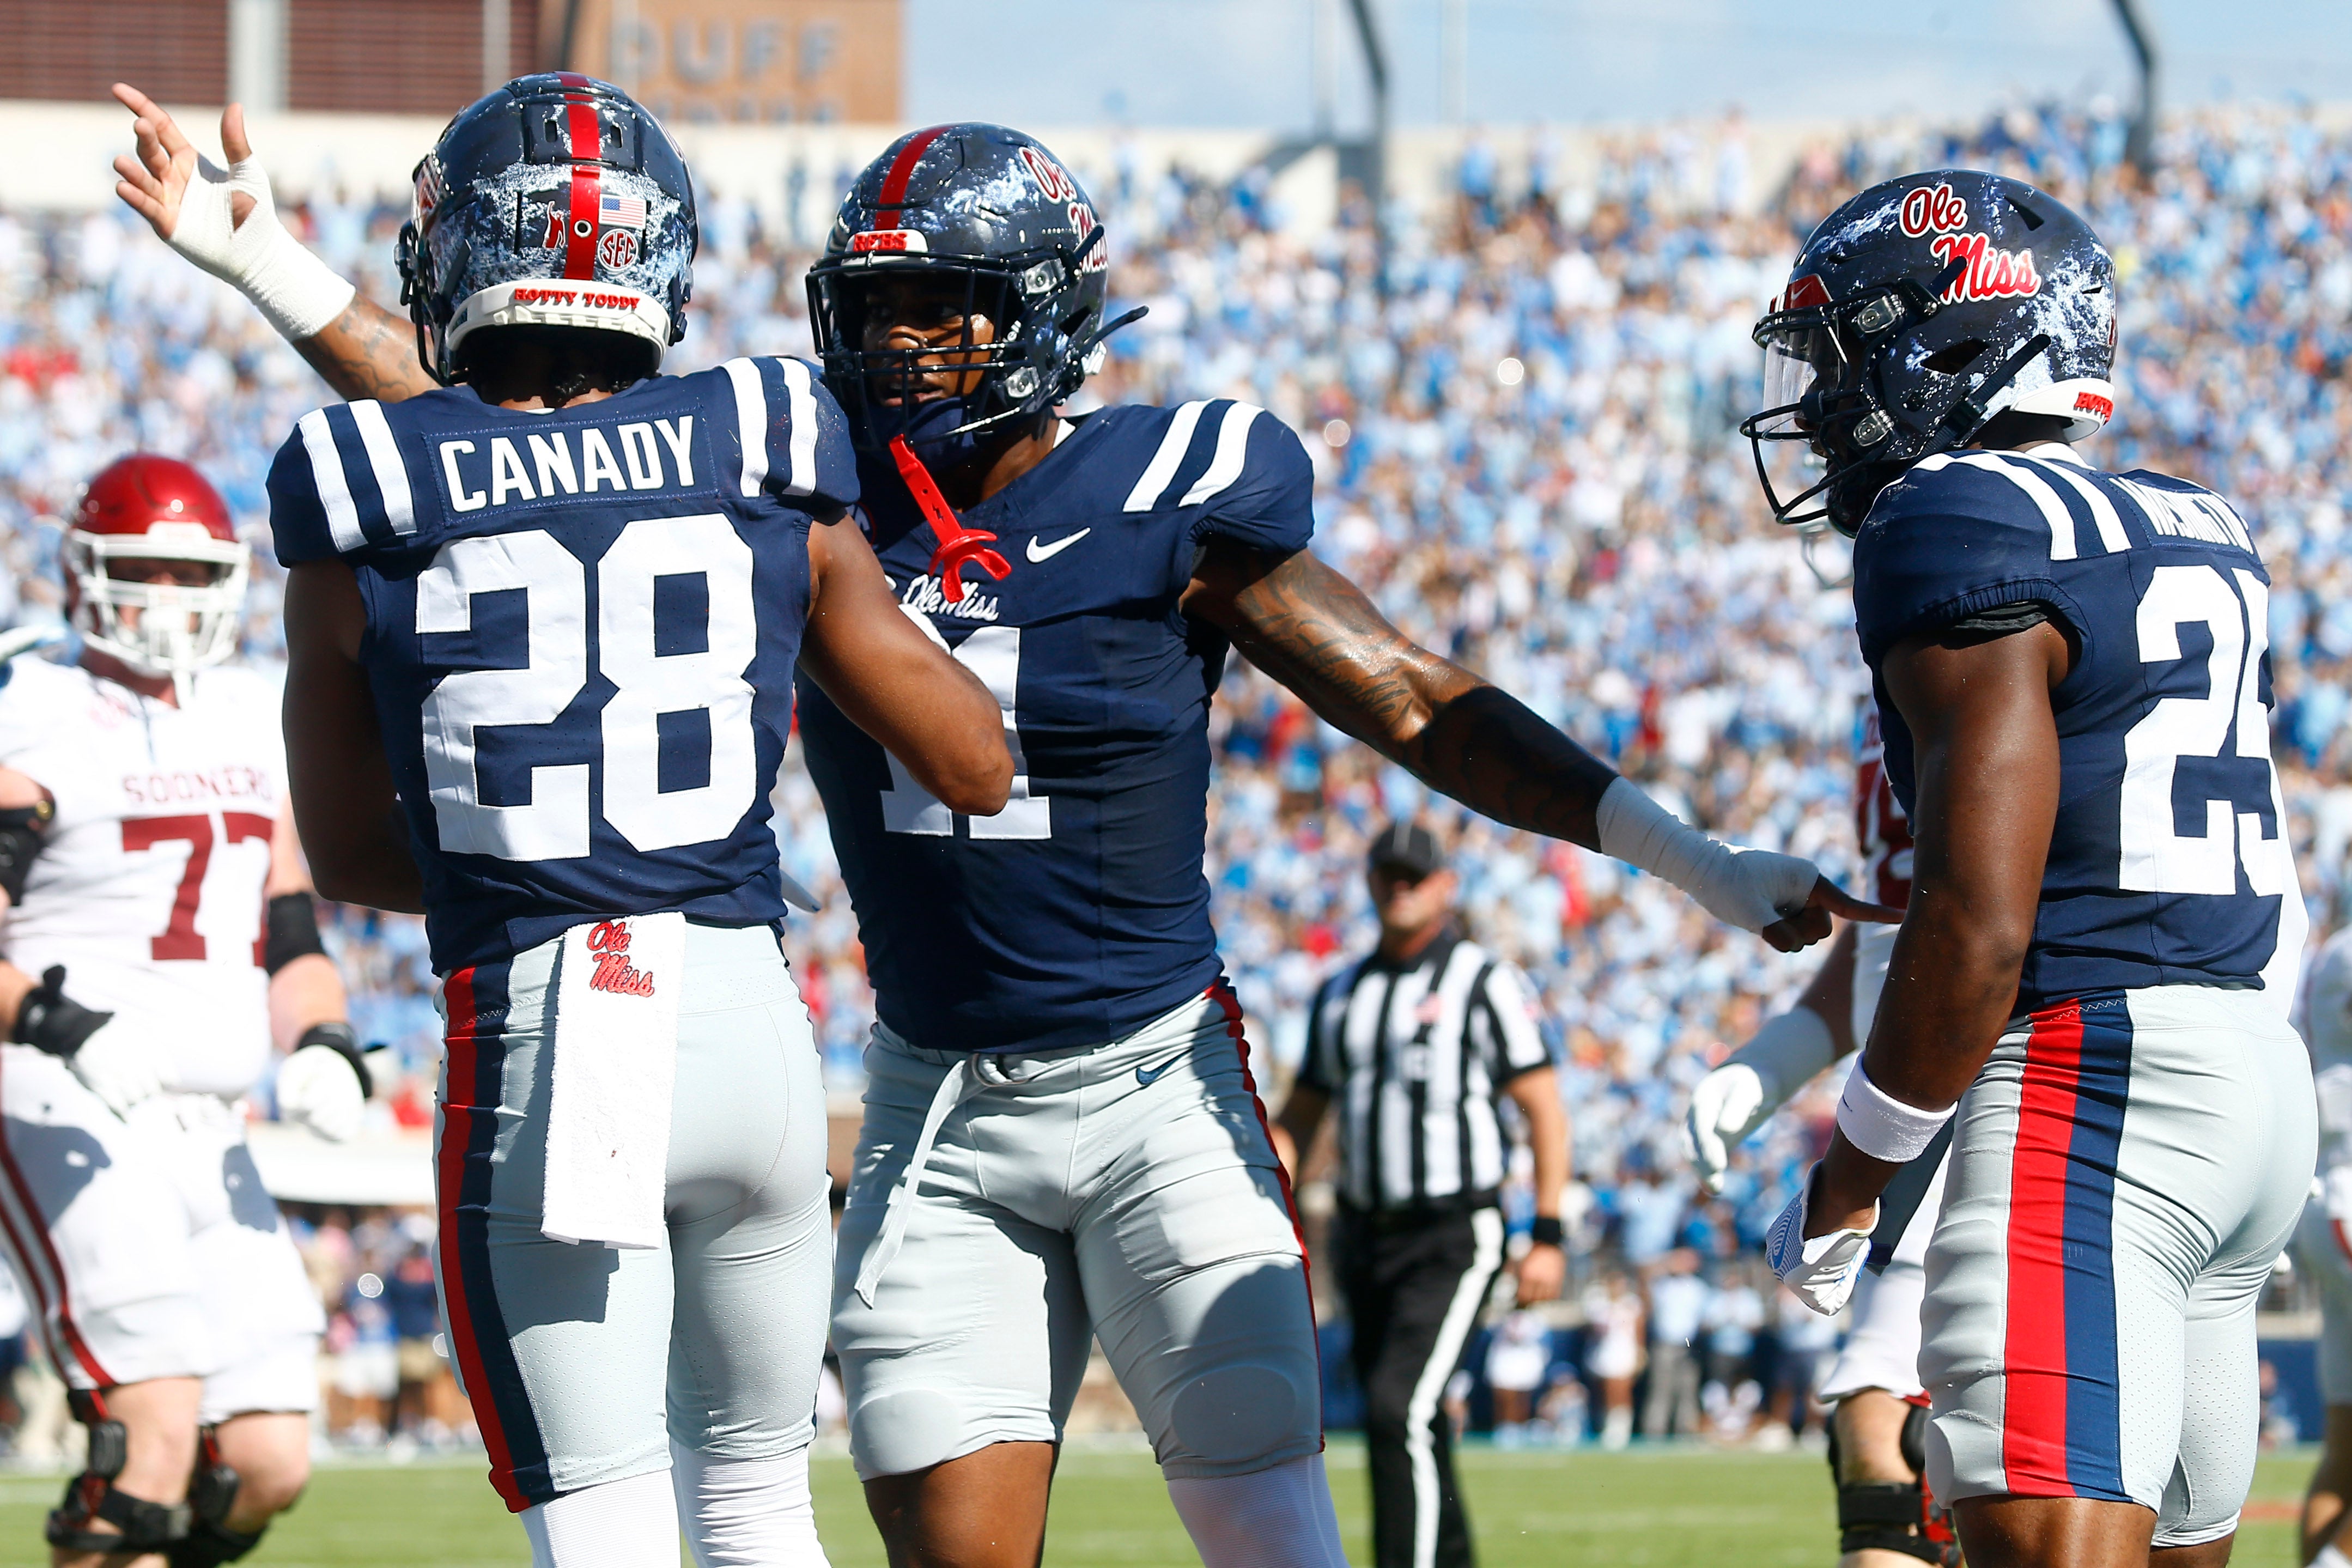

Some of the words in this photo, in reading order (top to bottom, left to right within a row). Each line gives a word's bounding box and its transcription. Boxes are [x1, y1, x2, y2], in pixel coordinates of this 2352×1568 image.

[1019, 146, 1077, 204] Ole
[1900, 184, 1968, 238] Ole
[602, 232, 635, 268] SEC
[853, 232, 908, 252] REBS
[1930, 232, 2041, 305] Miss
[514, 288, 578, 303] HOTTY
[584, 293, 640, 309] TODDY
[439, 416, 695, 513] CANADY
[902, 574, 943, 613] Ole
[415, 512, 758, 862] 28
[121, 811, 275, 968] 77
[587, 922, 631, 952] Ole
[590, 952, 655, 998] Miss
